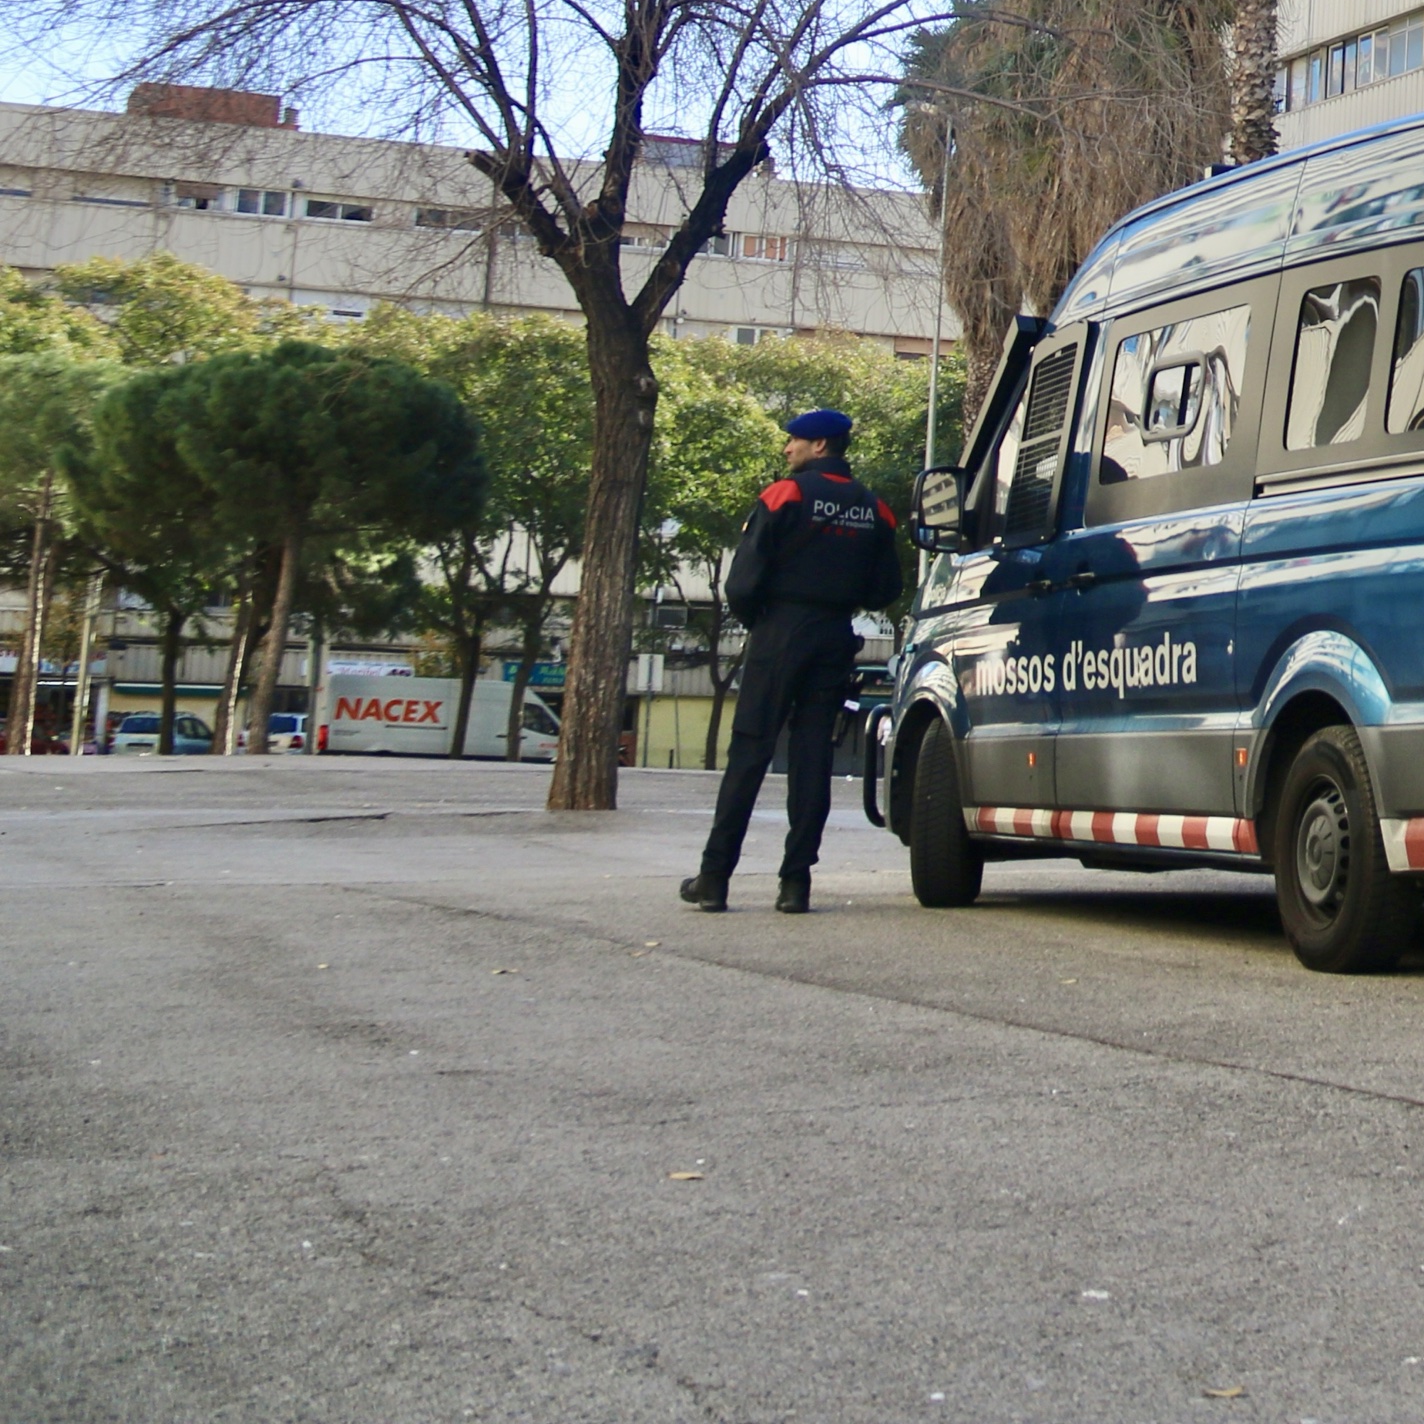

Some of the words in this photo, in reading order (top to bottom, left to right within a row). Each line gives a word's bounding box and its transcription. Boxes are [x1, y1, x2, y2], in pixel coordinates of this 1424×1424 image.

[975, 650, 1055, 696] mossos
[1062, 631, 1197, 699] d'esquadra
[334, 697, 443, 723] NACEX
